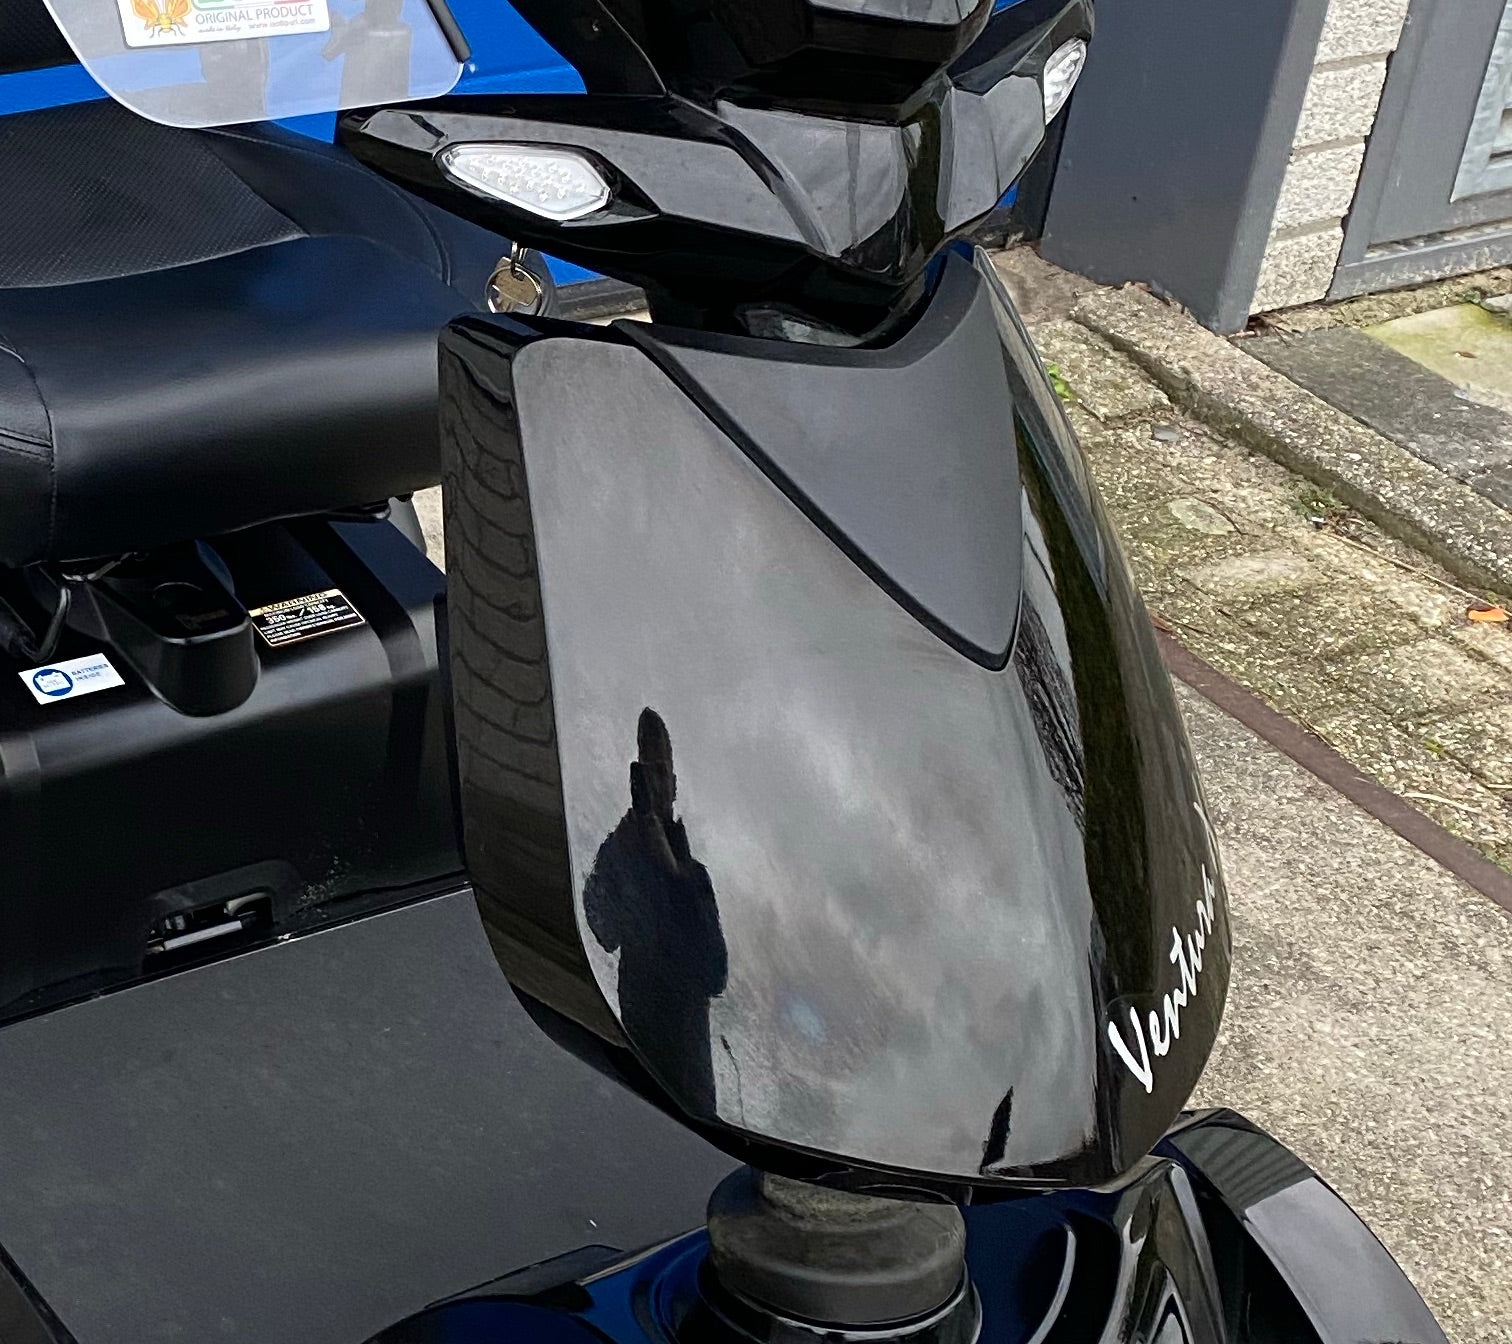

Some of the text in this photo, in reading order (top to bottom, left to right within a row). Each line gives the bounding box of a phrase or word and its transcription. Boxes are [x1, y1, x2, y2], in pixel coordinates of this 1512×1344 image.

[195, 3, 315, 25] ORIGINAL PRODUCT
[268, 592, 328, 611] WARNING
[266, 615, 286, 624] 350
[71, 663, 109, 676] BATTERIES
[1107, 863, 1216, 1094] Ventura
